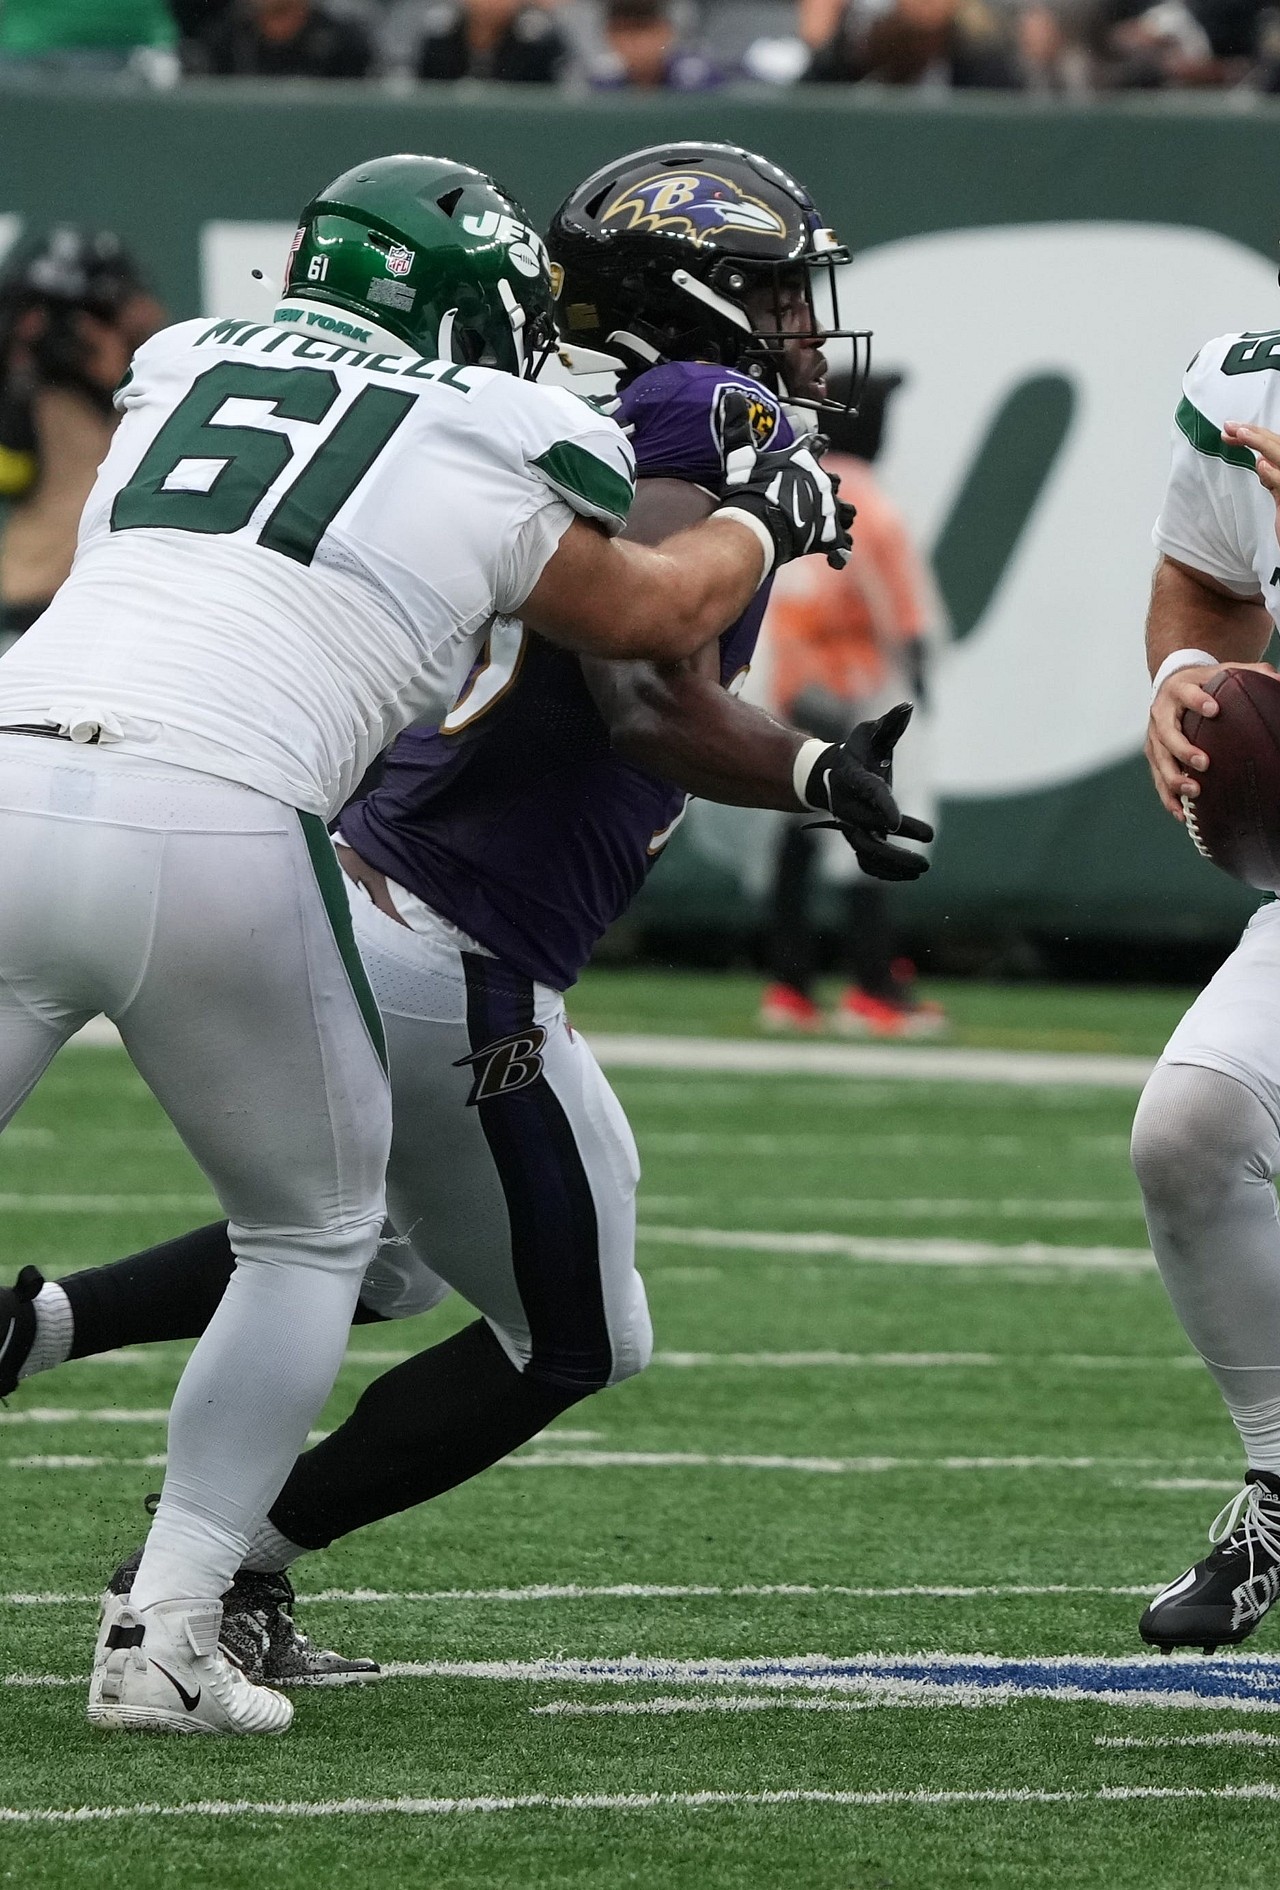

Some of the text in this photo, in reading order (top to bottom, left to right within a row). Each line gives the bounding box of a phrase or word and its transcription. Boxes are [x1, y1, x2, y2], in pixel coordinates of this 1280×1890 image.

[638, 176, 700, 212] B
[307, 255, 329, 282] 61
[306, 312, 374, 344] YORK
[110, 360, 419, 568] 61
